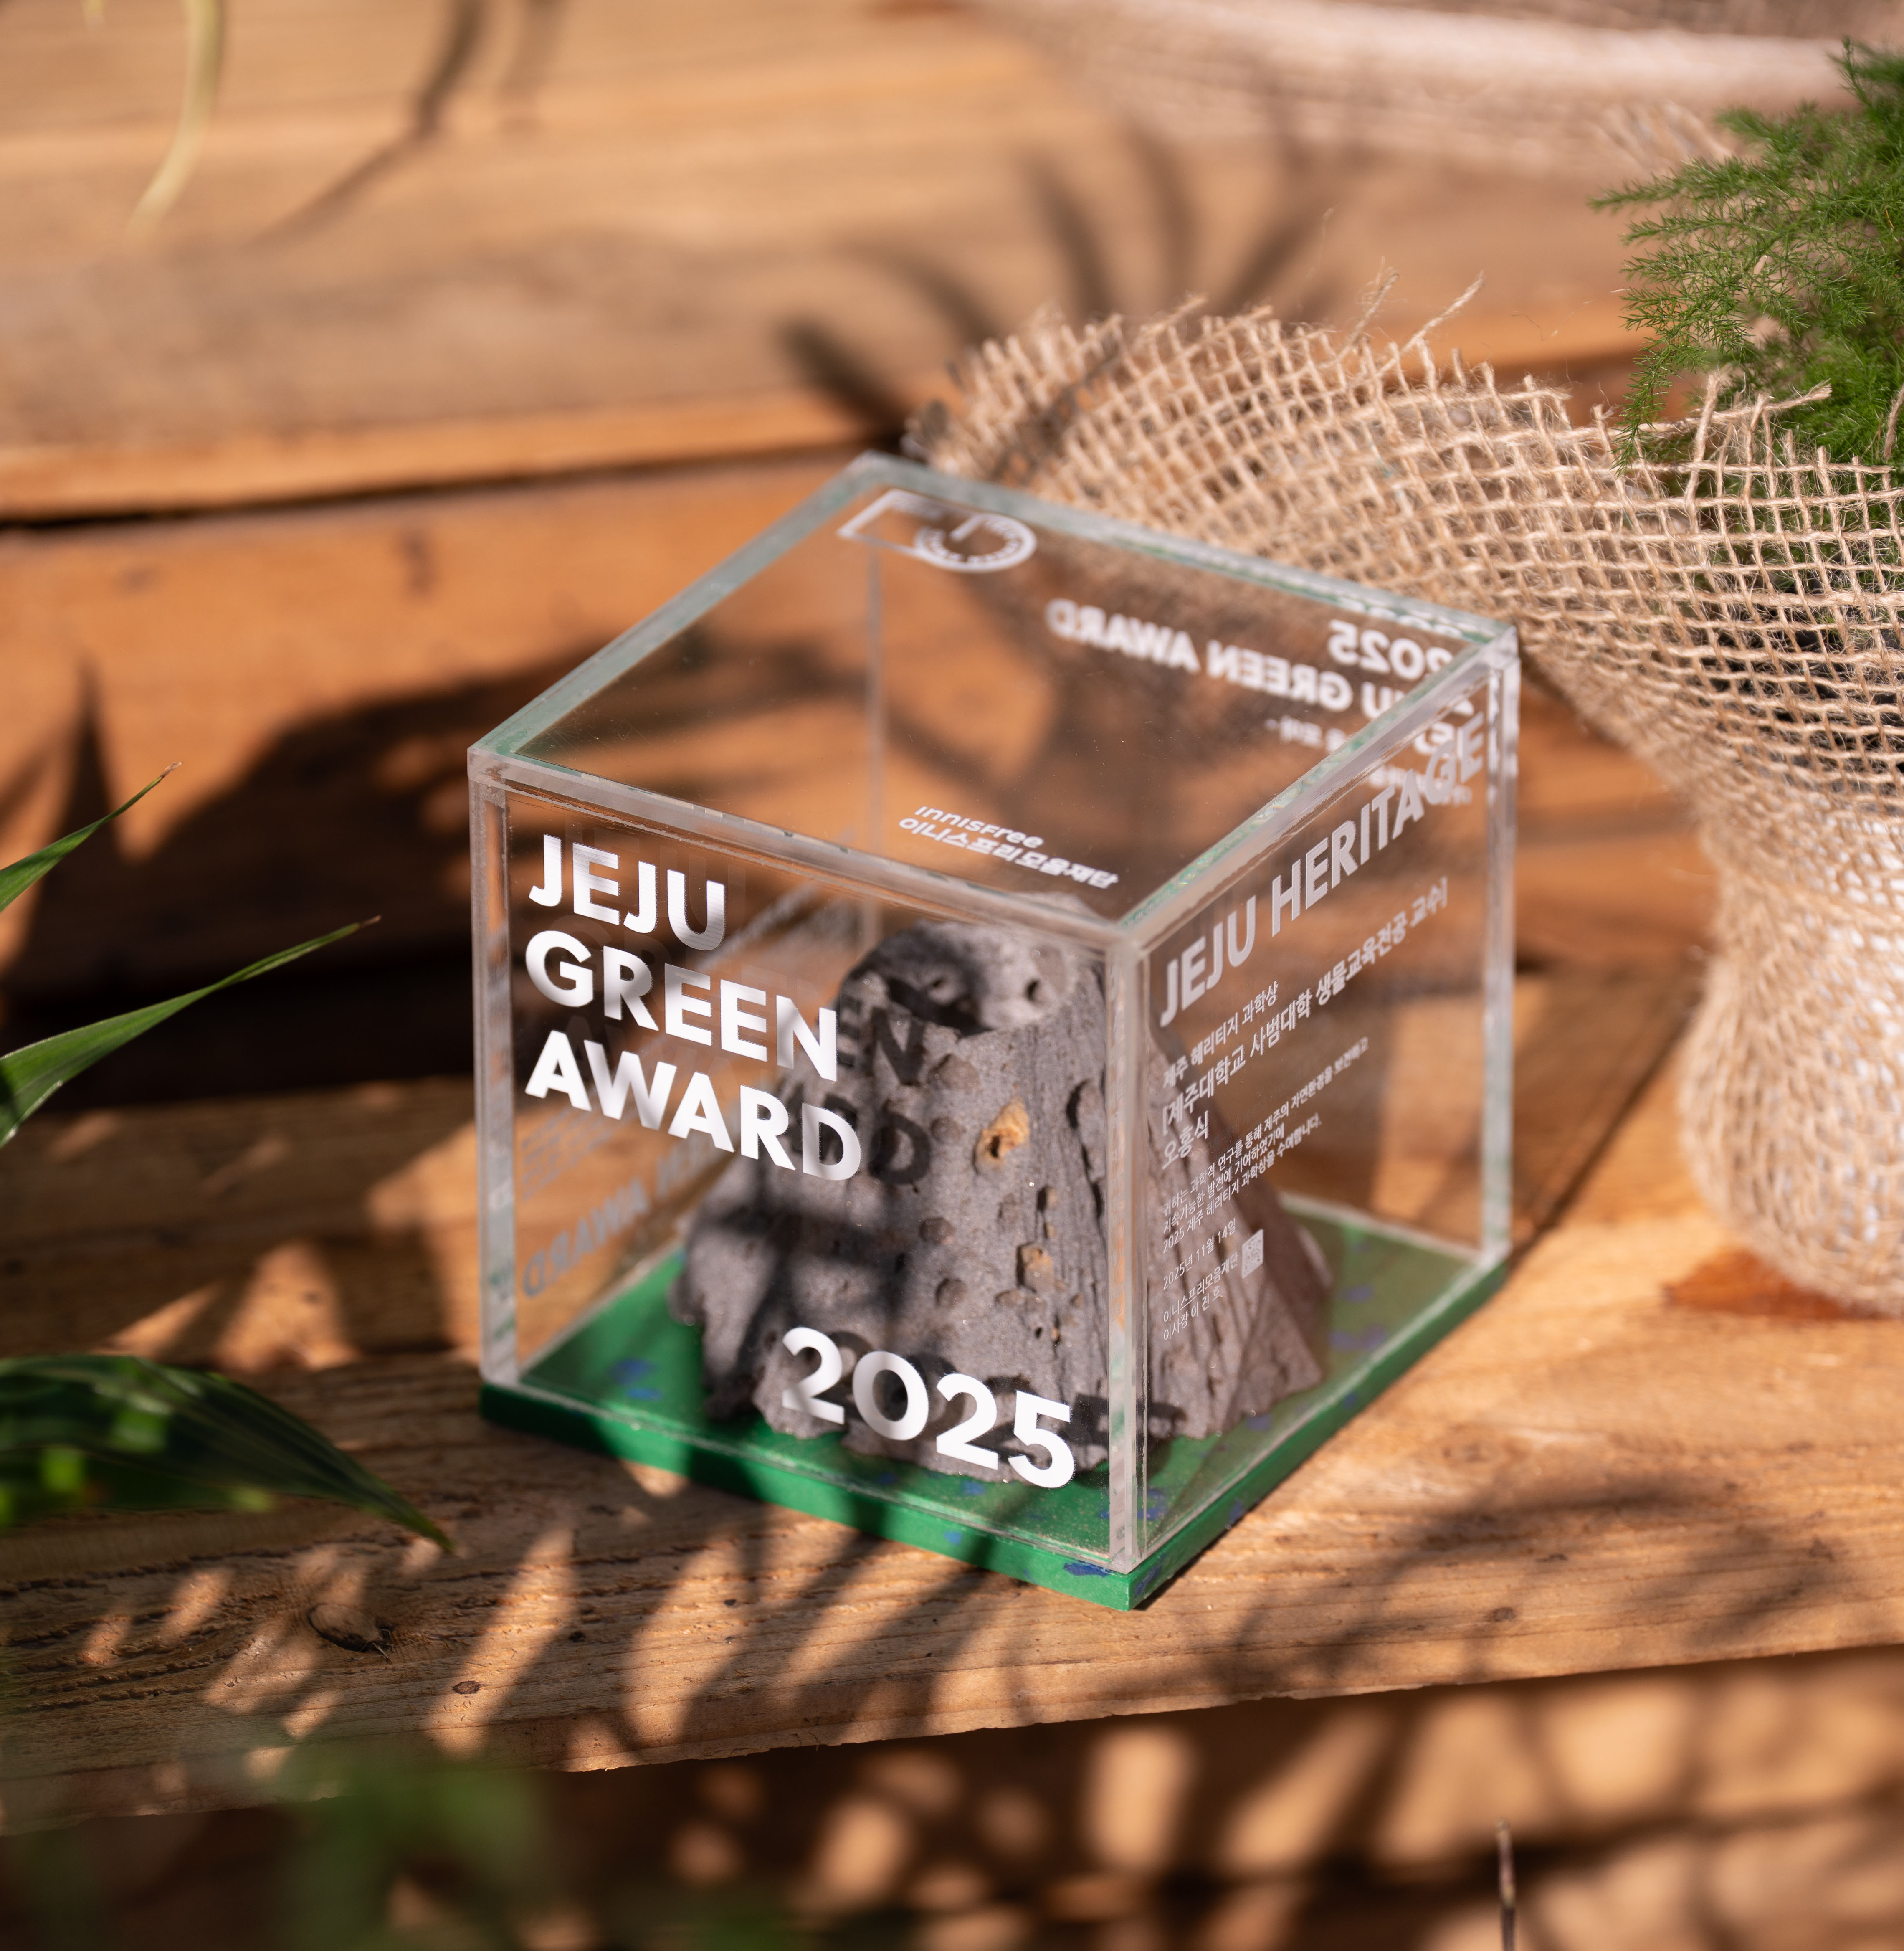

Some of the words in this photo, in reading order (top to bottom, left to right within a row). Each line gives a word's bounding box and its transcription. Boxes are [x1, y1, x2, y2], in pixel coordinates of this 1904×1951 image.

[528, 834, 726, 951] JEJU
[899, 818, 1119, 889] 이니스프리모음재단
[1160, 895, 1256, 1027] JEJU
[1271, 711, 1484, 937] HERITAGE
[525, 930, 837, 1082] GREEN
[1162, 1044, 1246, 1136] [제주대학교
[1250, 988, 1313, 1058] 사범대학
[1316, 910, 1408, 1006] 생물교육전공
[1163, 1055, 1189, 1089] 제주
[1190, 1012, 1239, 1066] 헤리티지
[1241, 980, 1279, 1025] 과학상
[524, 1030, 862, 1181] AWARD
[1162, 1110, 1209, 1170] 오홍식
[1163, 1189, 1189, 1217] 귀하는
[1190, 1162, 1215, 1193] 과학적
[1218, 1139, 1243, 1172] 연구를
[1245, 1123, 1262, 1149] 통해
[1263, 1101, 1289, 1132] 제주의
[1163, 1190, 1205, 1234] 지속가능한
[1207, 1166, 1232, 1199] 발전에
[1234, 1122, 1285, 1175] 기여하였기에
[1163, 1226, 1185, 1254] 2025
[1187, 1209, 1204, 1232] 제주
[1206, 1178, 1239, 1216] 헤리티지
[1241, 1150, 1275, 1187] 과학상을
[1163, 1253, 1193, 1291] 2025년
[1196, 1235, 1215, 1262] 11월
[1217, 1217, 1236, 1244] 14일
[1163, 1252, 1238, 1323] 이니스프리모음재단
[1163, 1310, 1189, 1340] 이사장
[782, 1326, 1075, 1489] 2025
